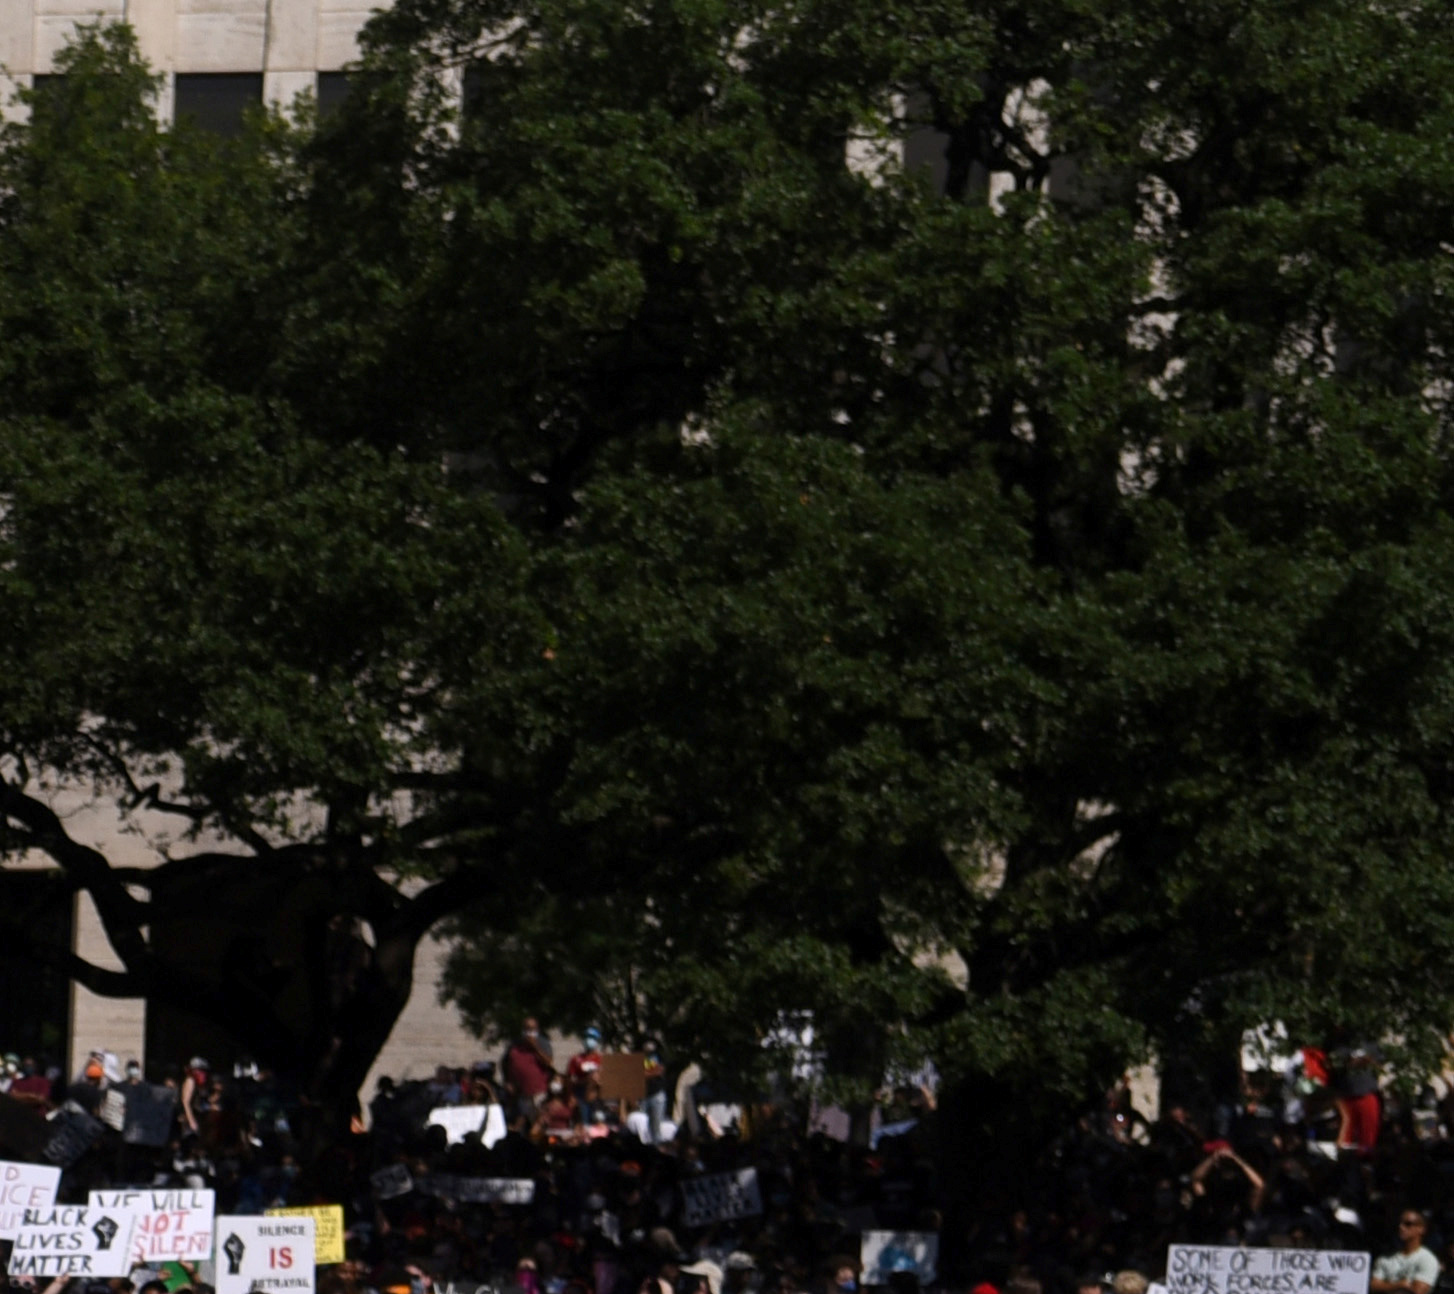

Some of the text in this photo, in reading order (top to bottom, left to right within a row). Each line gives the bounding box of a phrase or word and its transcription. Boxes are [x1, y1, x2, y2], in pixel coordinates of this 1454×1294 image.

[21, 1208, 88, 1227] BLACK
[258, 1225, 305, 1236] SILENCE
[16, 1232, 83, 1251] LIVES
[12, 1255, 93, 1274] MATTER
[269, 1247, 293, 1269] IS
[1172, 1251, 1366, 1273] SOME OF THOSE WHO
[1299, 1275, 1339, 1292] ARE
